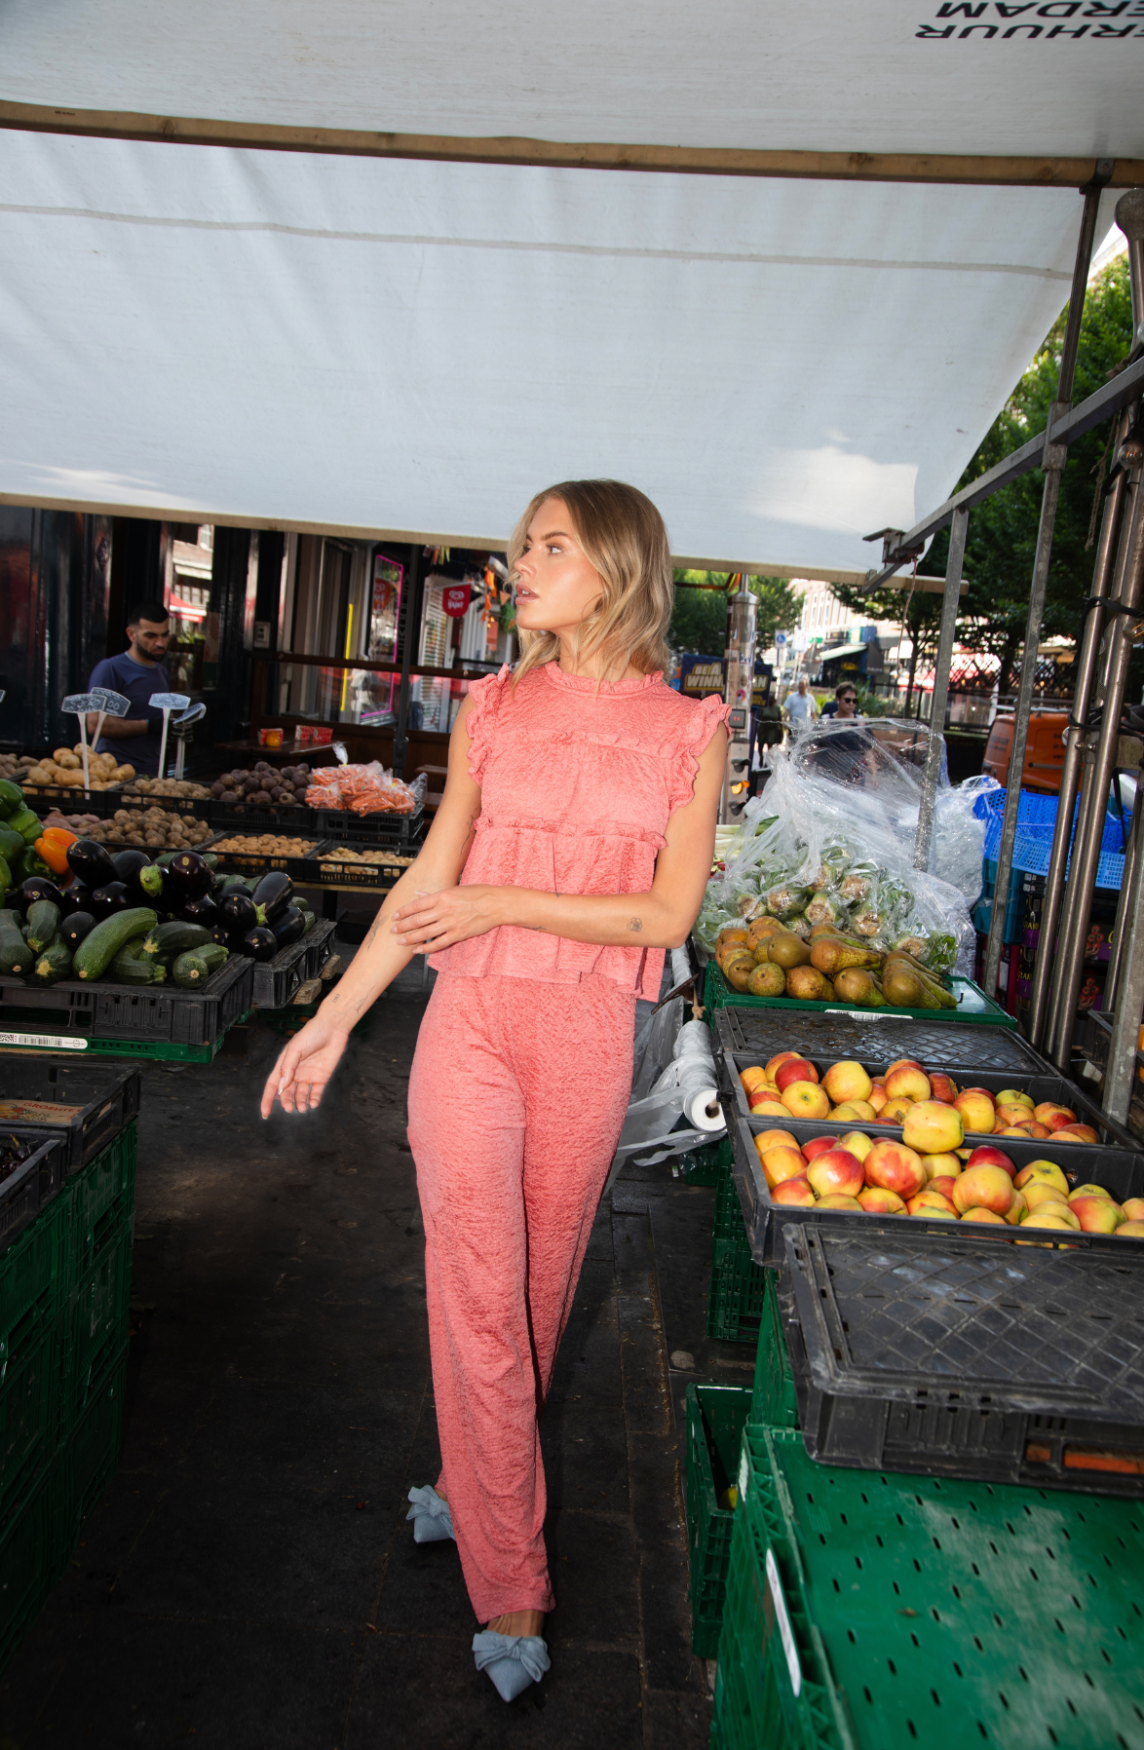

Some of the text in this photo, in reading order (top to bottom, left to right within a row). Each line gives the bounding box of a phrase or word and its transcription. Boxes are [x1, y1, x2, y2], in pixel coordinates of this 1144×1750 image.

[915, 23, 1144, 39] RHUUR
[687, 675, 723, 687] WINN
[23, 1102, 74, 1113] GROENTE
